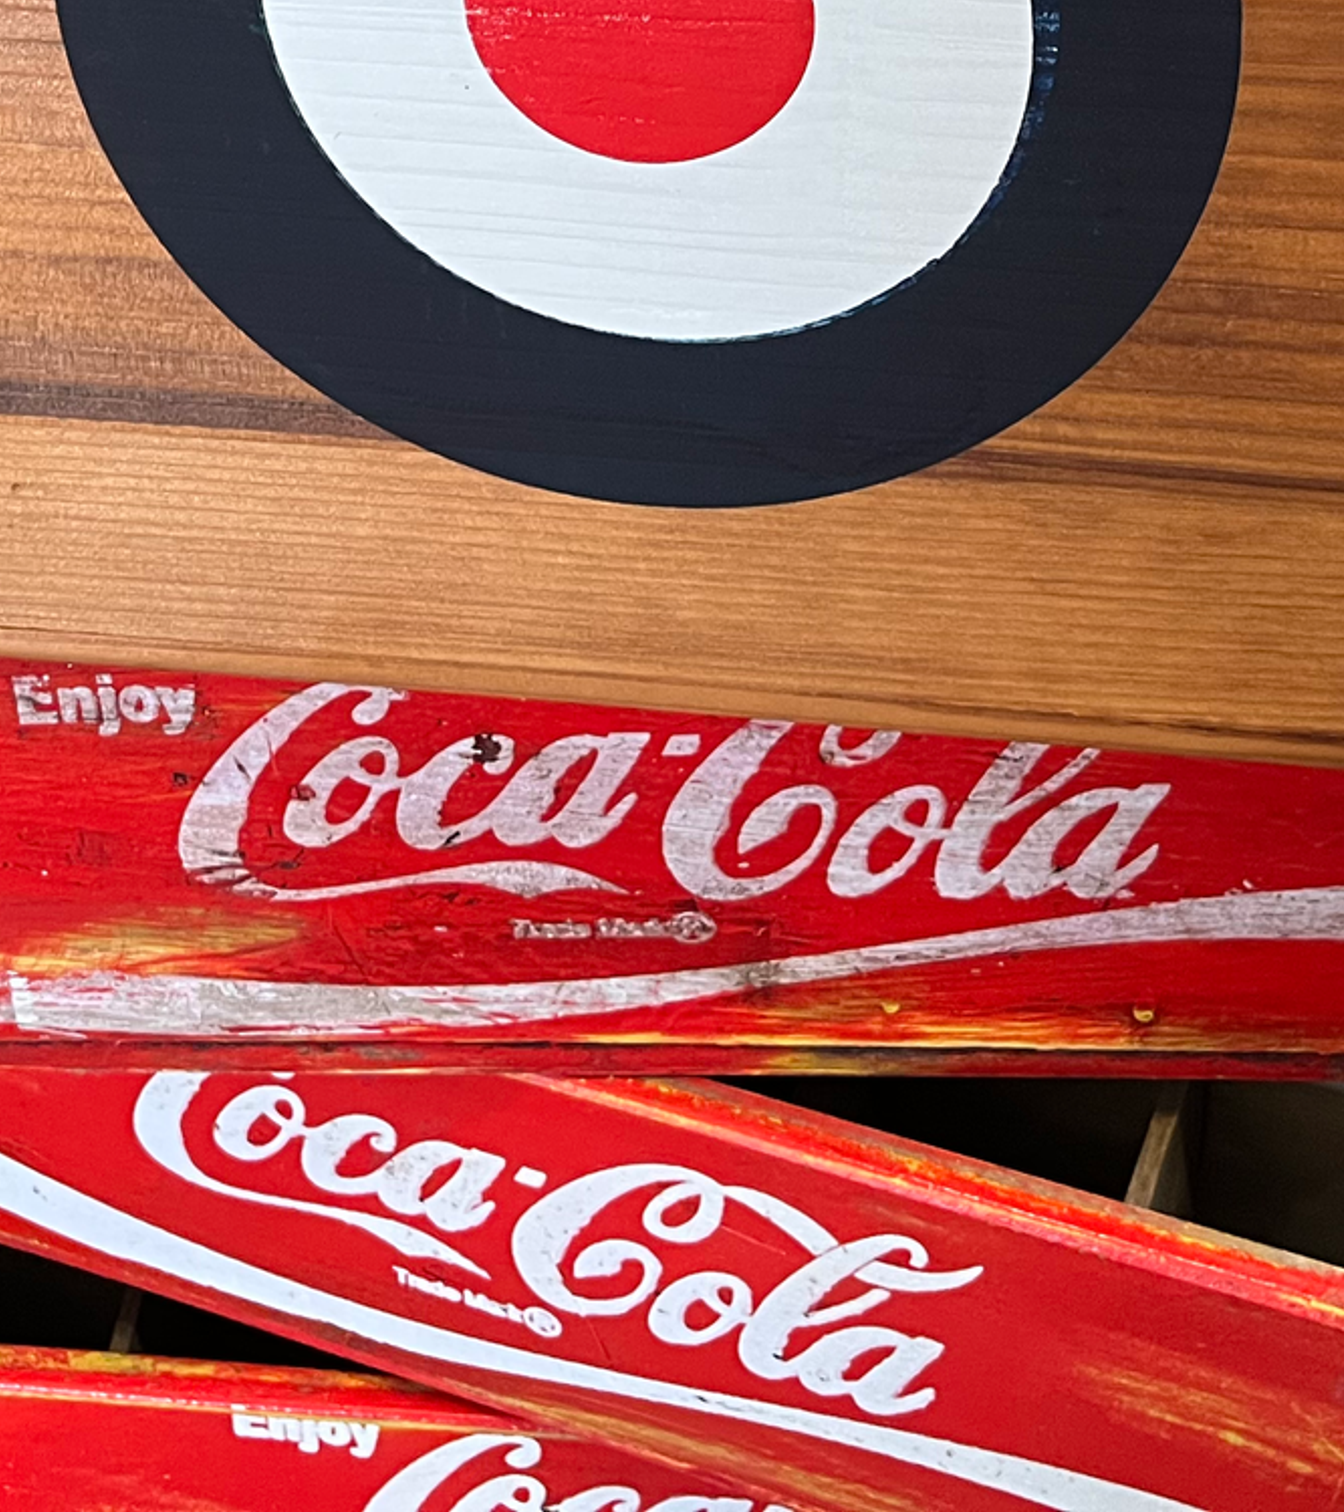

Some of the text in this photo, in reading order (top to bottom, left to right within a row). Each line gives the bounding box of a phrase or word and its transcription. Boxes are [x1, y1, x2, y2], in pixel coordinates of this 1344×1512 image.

[11, 674, 196, 736] Enjoy
[133, 1072, 984, 1415] Coca-Cola
[231, 1404, 380, 1458] Enjoy
